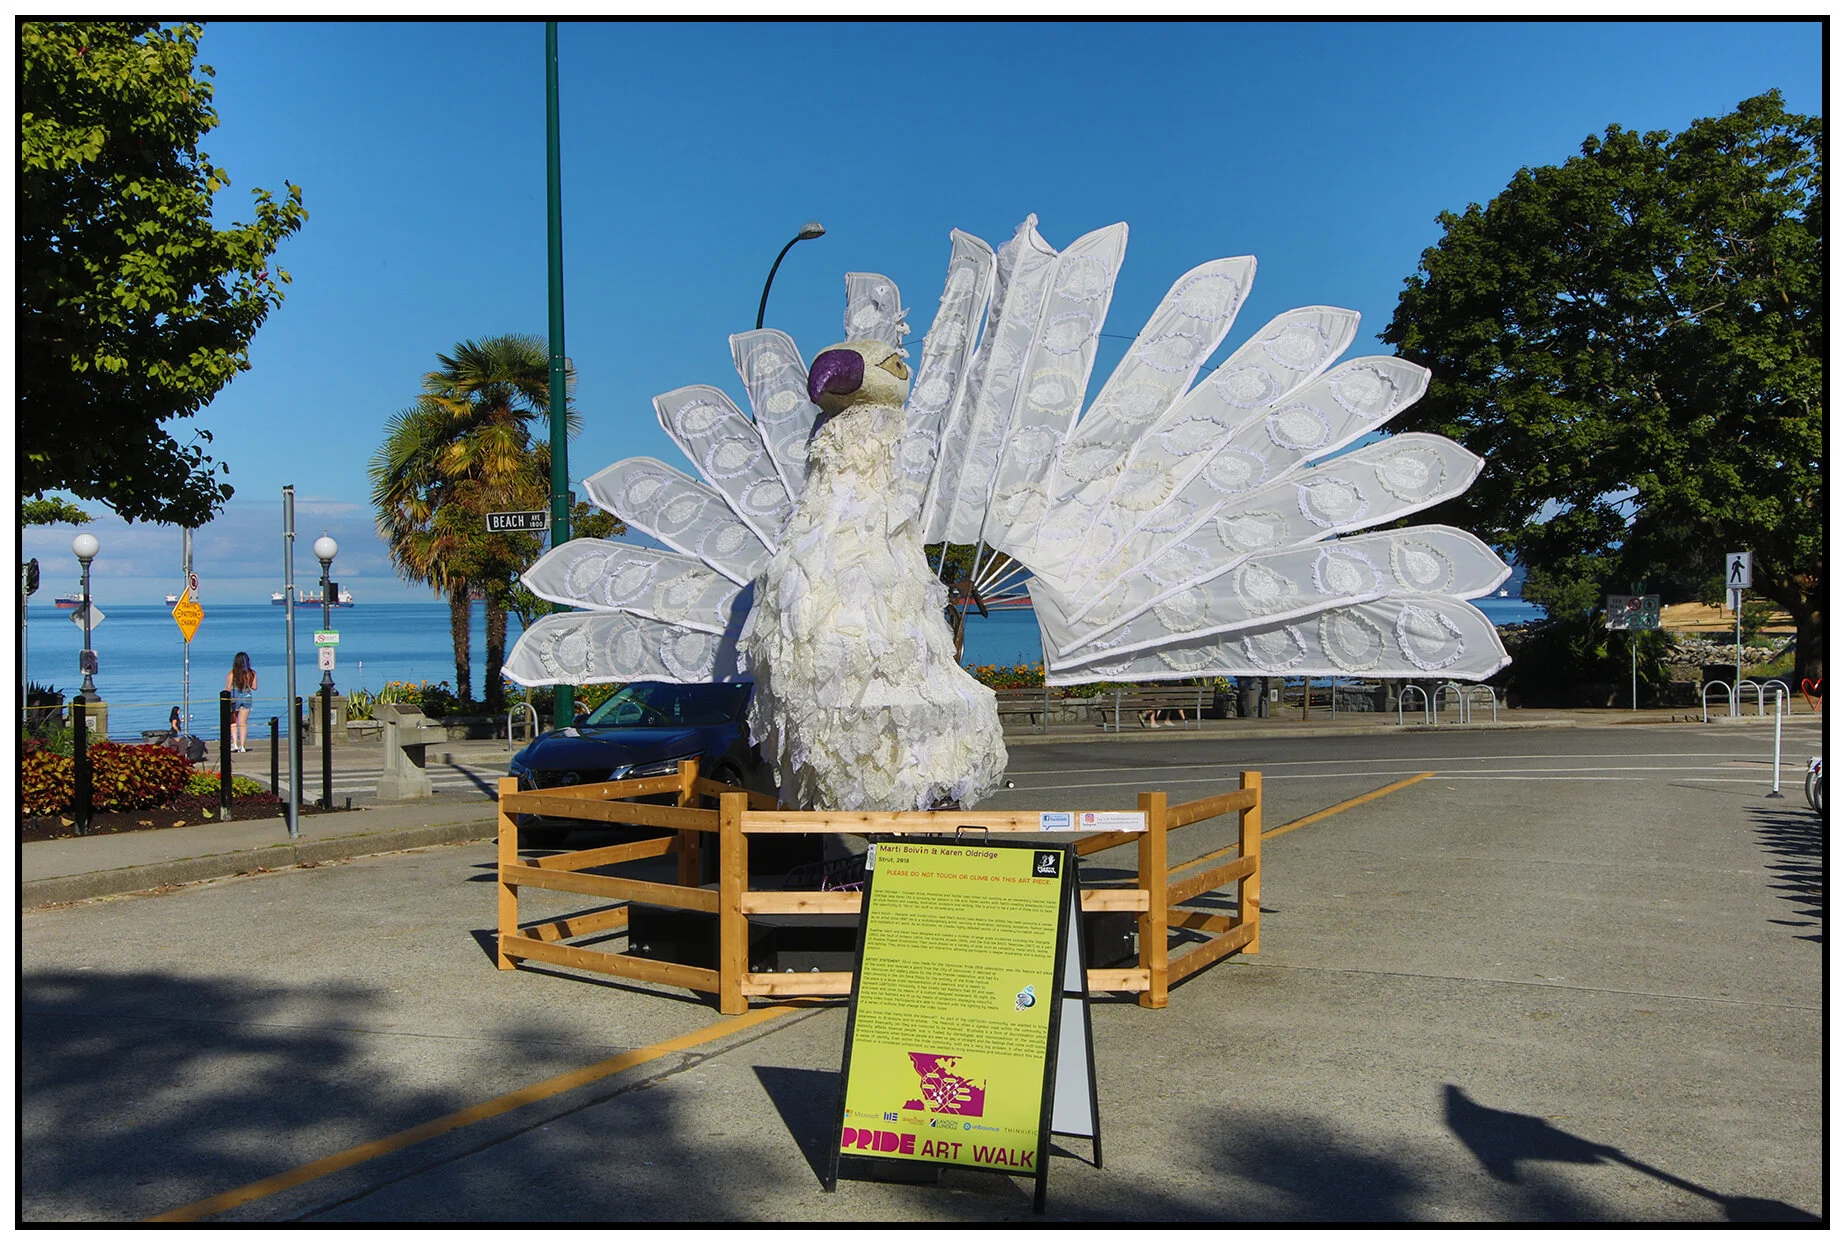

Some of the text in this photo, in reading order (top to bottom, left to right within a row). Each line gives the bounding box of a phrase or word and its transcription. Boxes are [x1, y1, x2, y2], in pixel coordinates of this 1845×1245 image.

[493, 516, 524, 528] BEACH
[904, 846, 929, 854] Boivin
[966, 850, 998, 859] Oldridge
[842, 1127, 1035, 1168] PRIDE ART WALK
